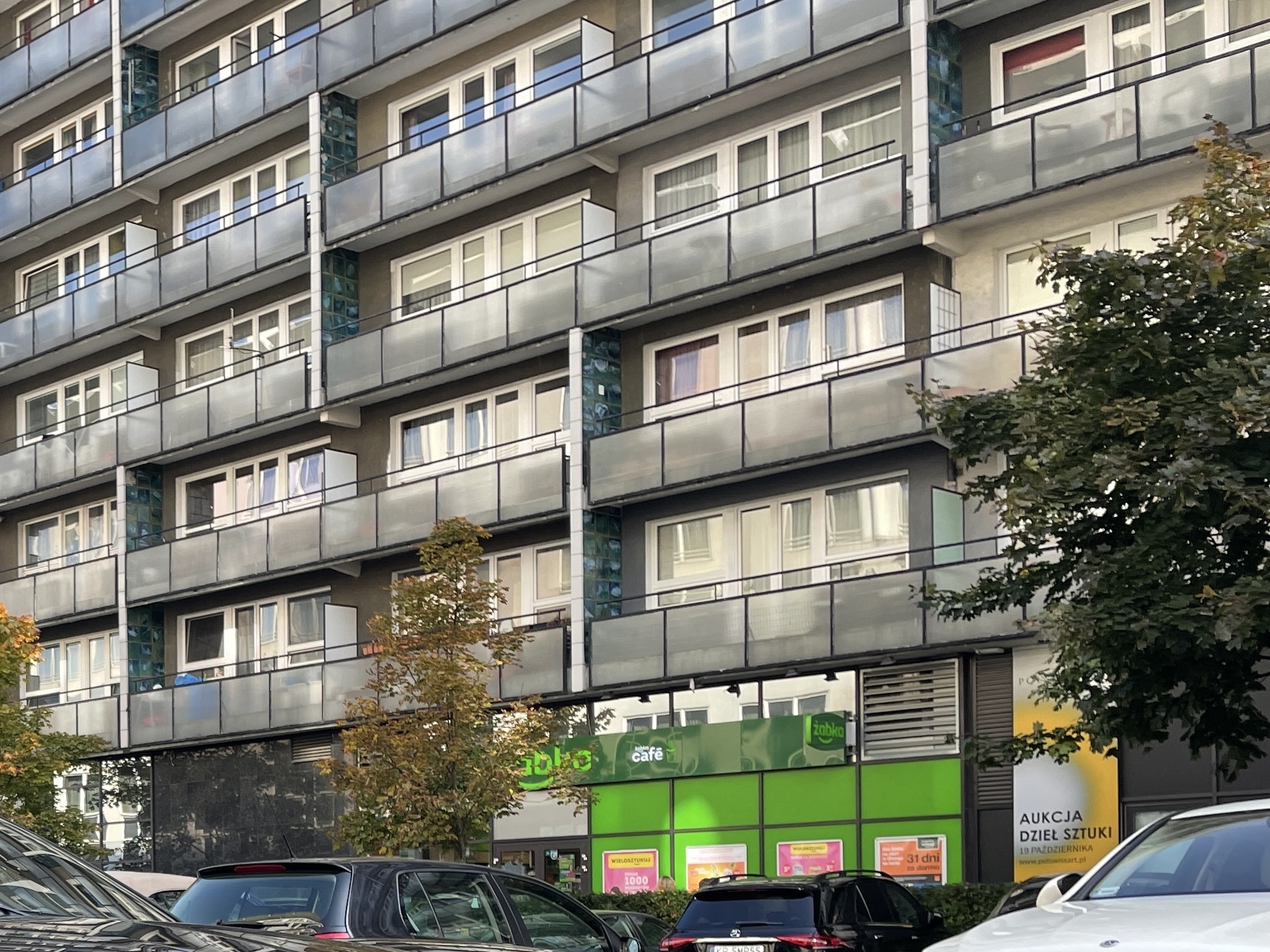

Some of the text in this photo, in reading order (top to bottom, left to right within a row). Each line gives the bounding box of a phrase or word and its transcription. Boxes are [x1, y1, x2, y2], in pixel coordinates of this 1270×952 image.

[813, 720, 844, 738] żabka
[1019, 810, 1083, 825] AUKCJA
[1019, 826, 1112, 842] DZIEŁ SZTUKI
[1031, 844, 1094, 855] PAŹDZIERNIKA
[906, 853, 919, 863] 31
[921, 852, 940, 863] dni
[625, 875, 649, 885] 1000
